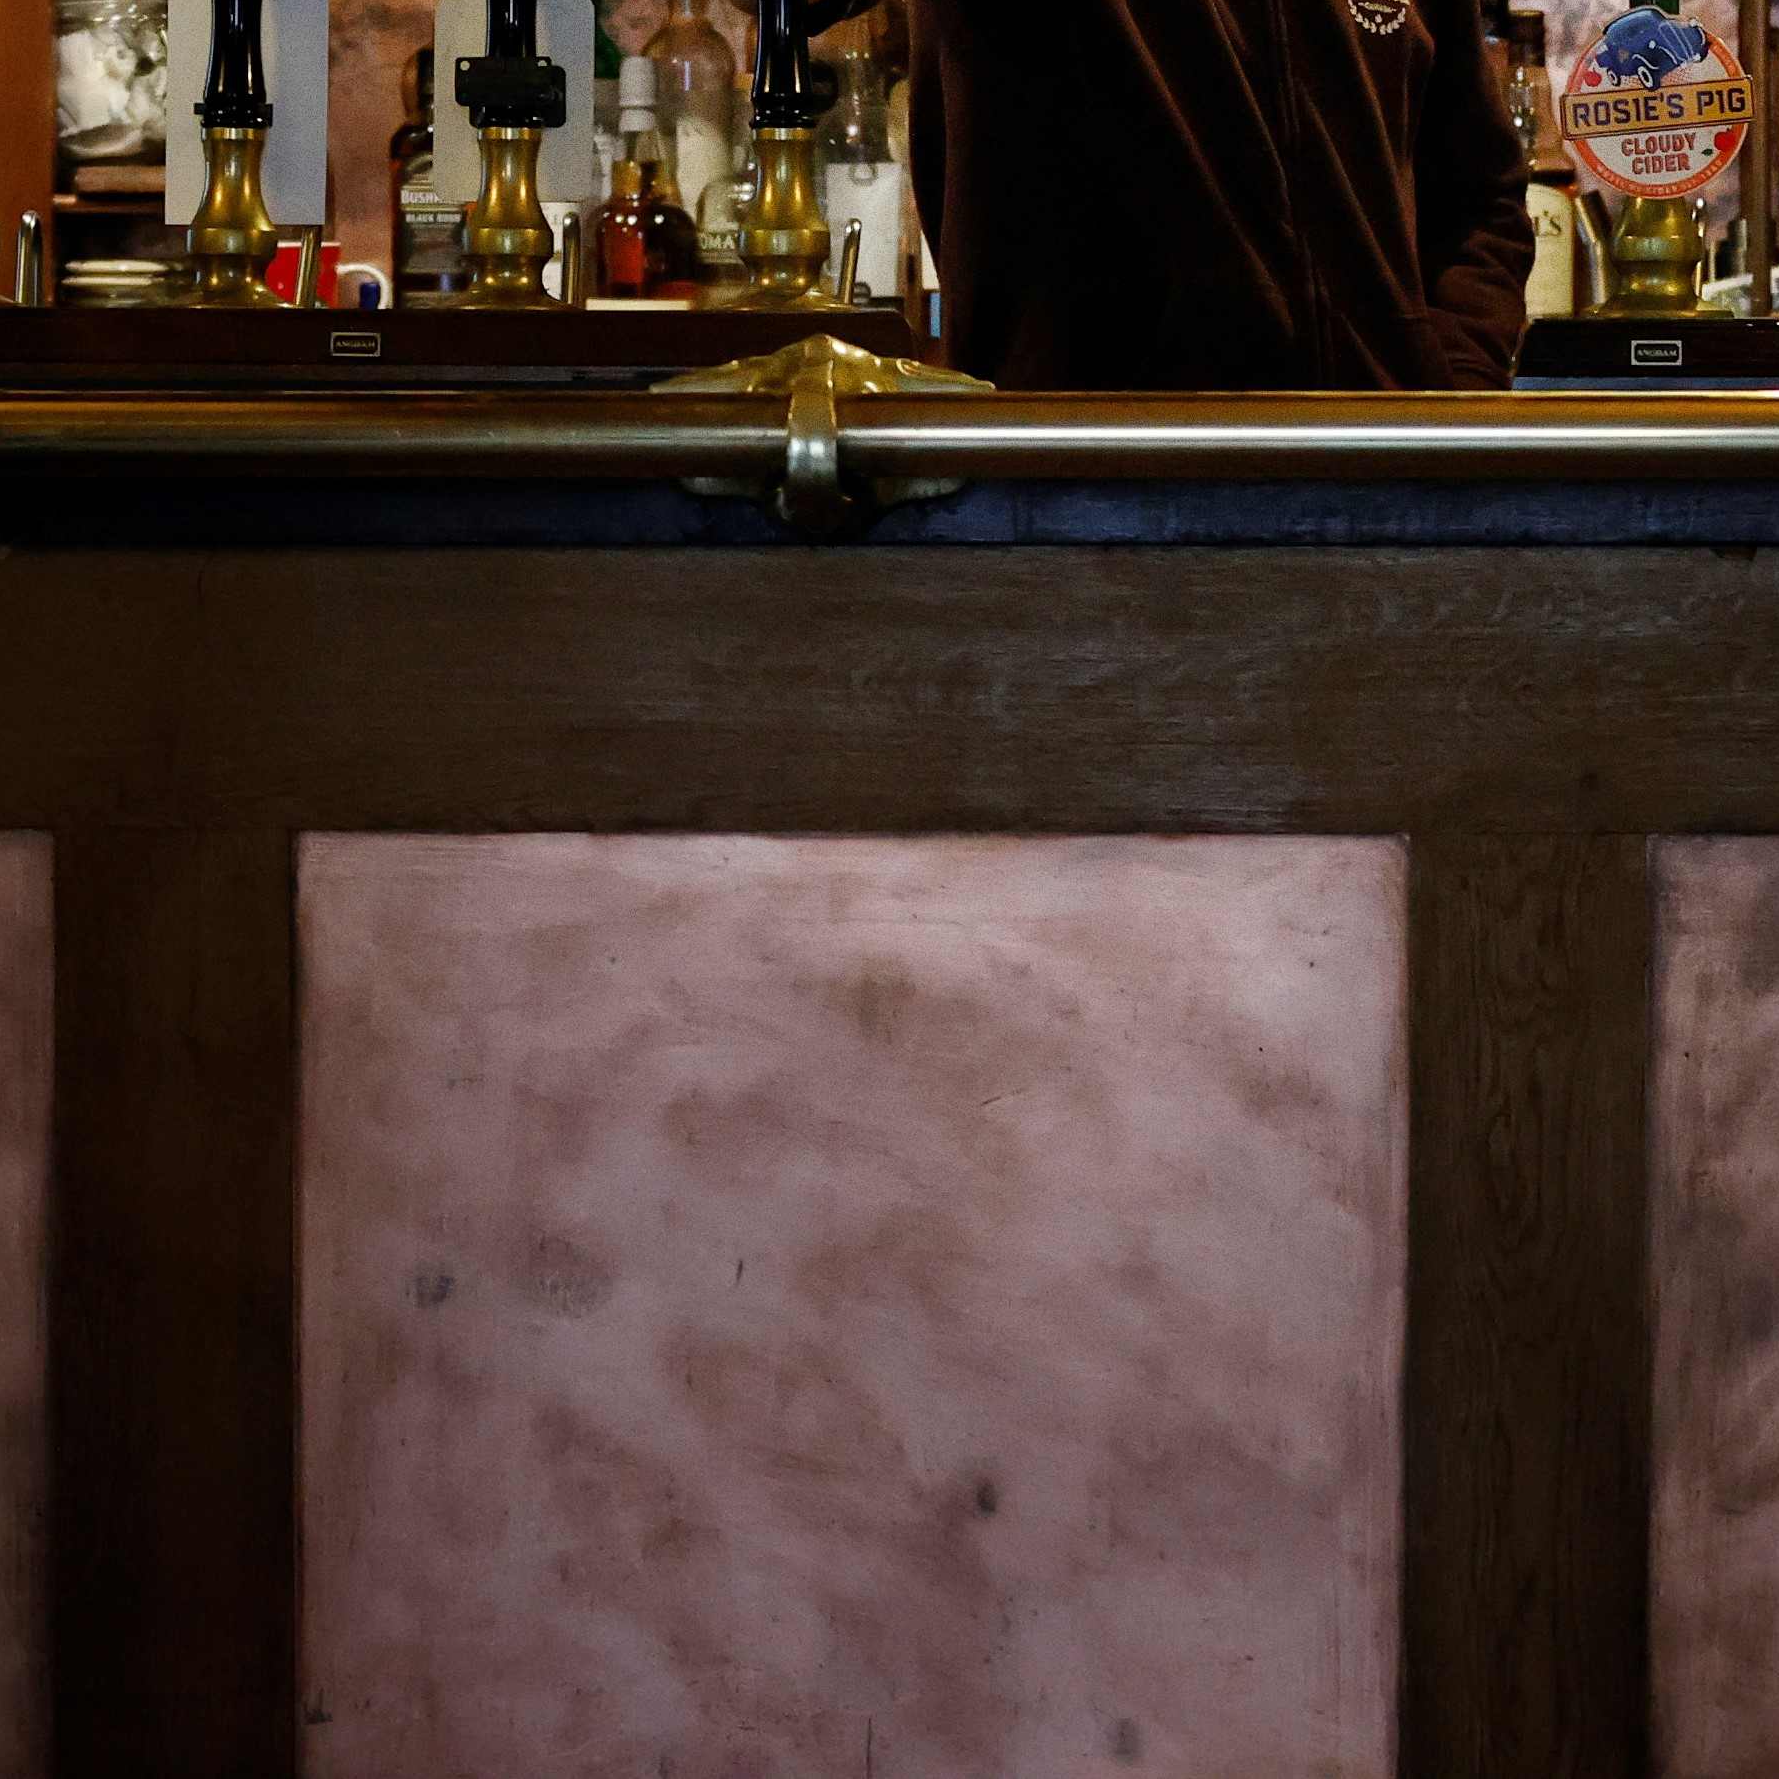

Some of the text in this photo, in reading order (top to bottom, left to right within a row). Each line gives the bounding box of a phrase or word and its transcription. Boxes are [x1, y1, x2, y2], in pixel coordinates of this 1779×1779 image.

[1572, 92, 1684, 128] ROSIE'S
[1620, 132, 1696, 157] CLOUDY
[1631, 152, 1691, 175] CIDER
